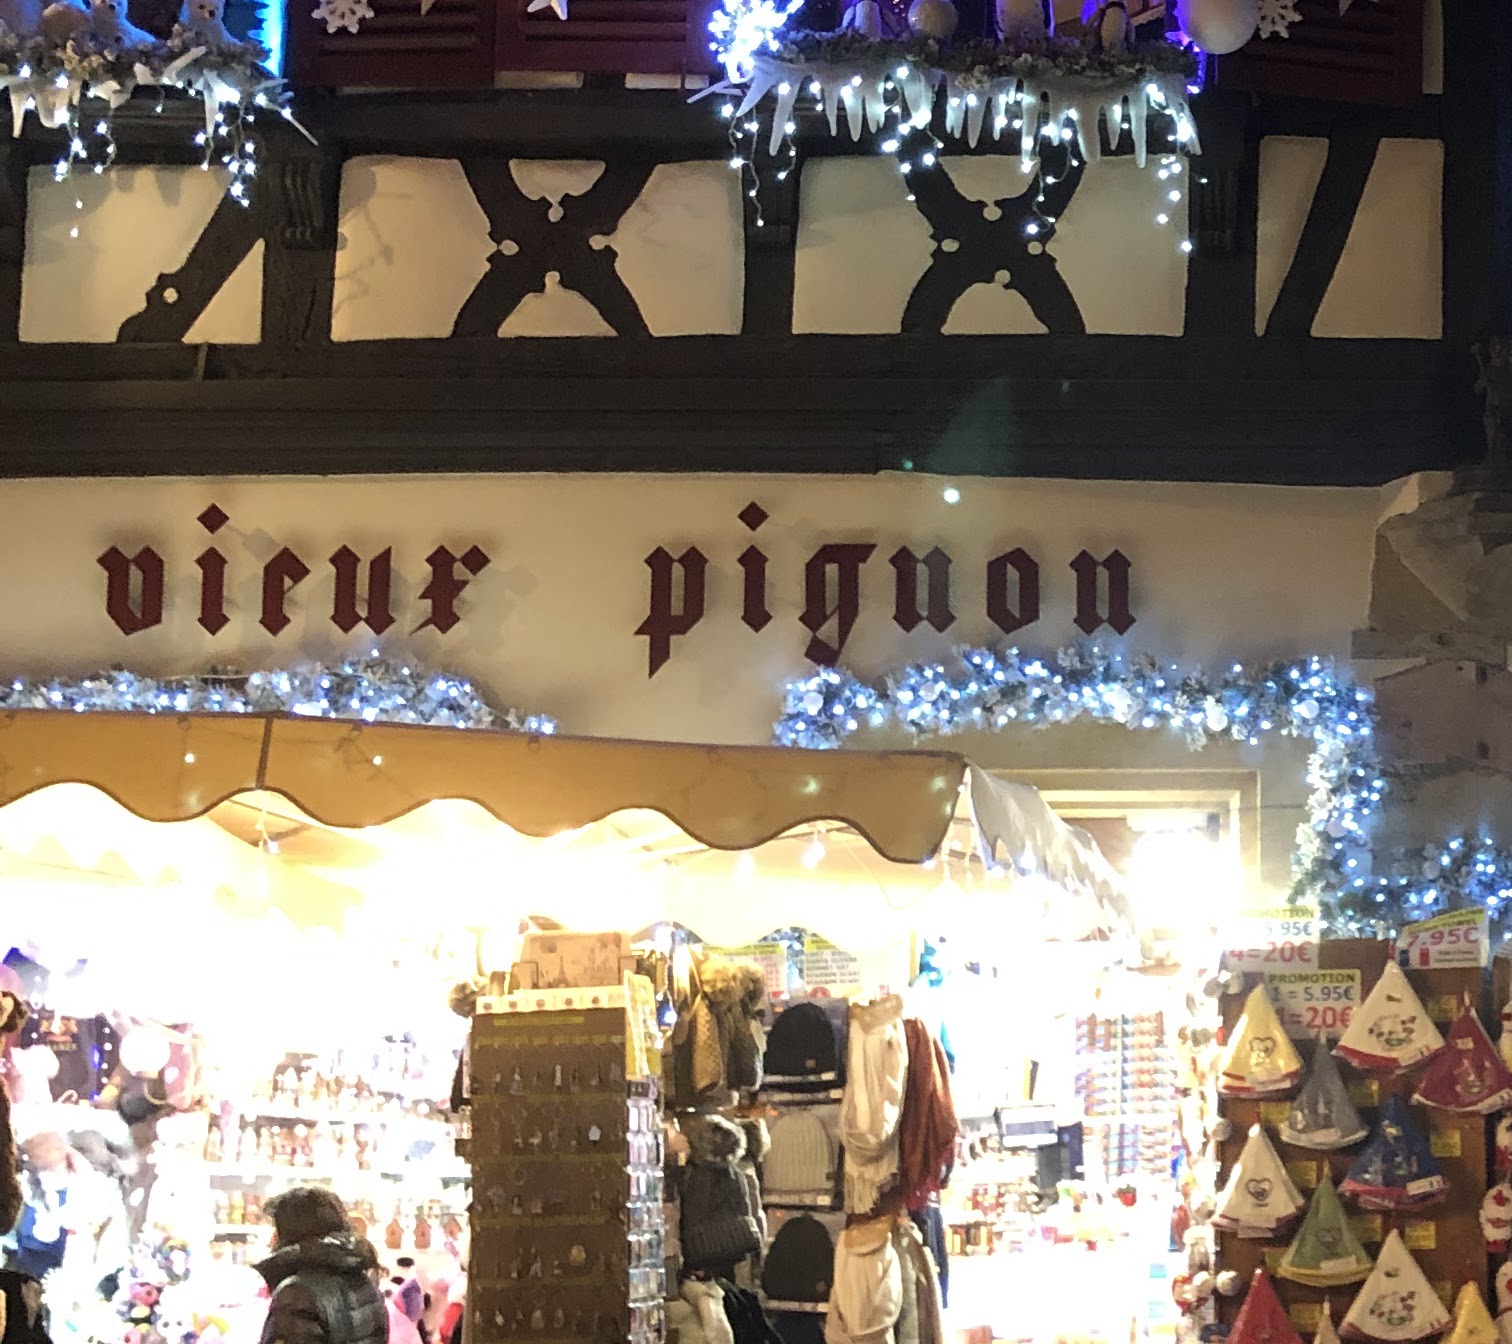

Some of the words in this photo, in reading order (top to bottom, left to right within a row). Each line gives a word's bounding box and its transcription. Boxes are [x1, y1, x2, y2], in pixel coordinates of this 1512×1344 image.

[96, 502, 491, 636] vieux
[633, 500, 1138, 679] pignon
[1269, 973, 1355, 984] PROMOTION
[1304, 985, 1354, 1001] 5.95€
